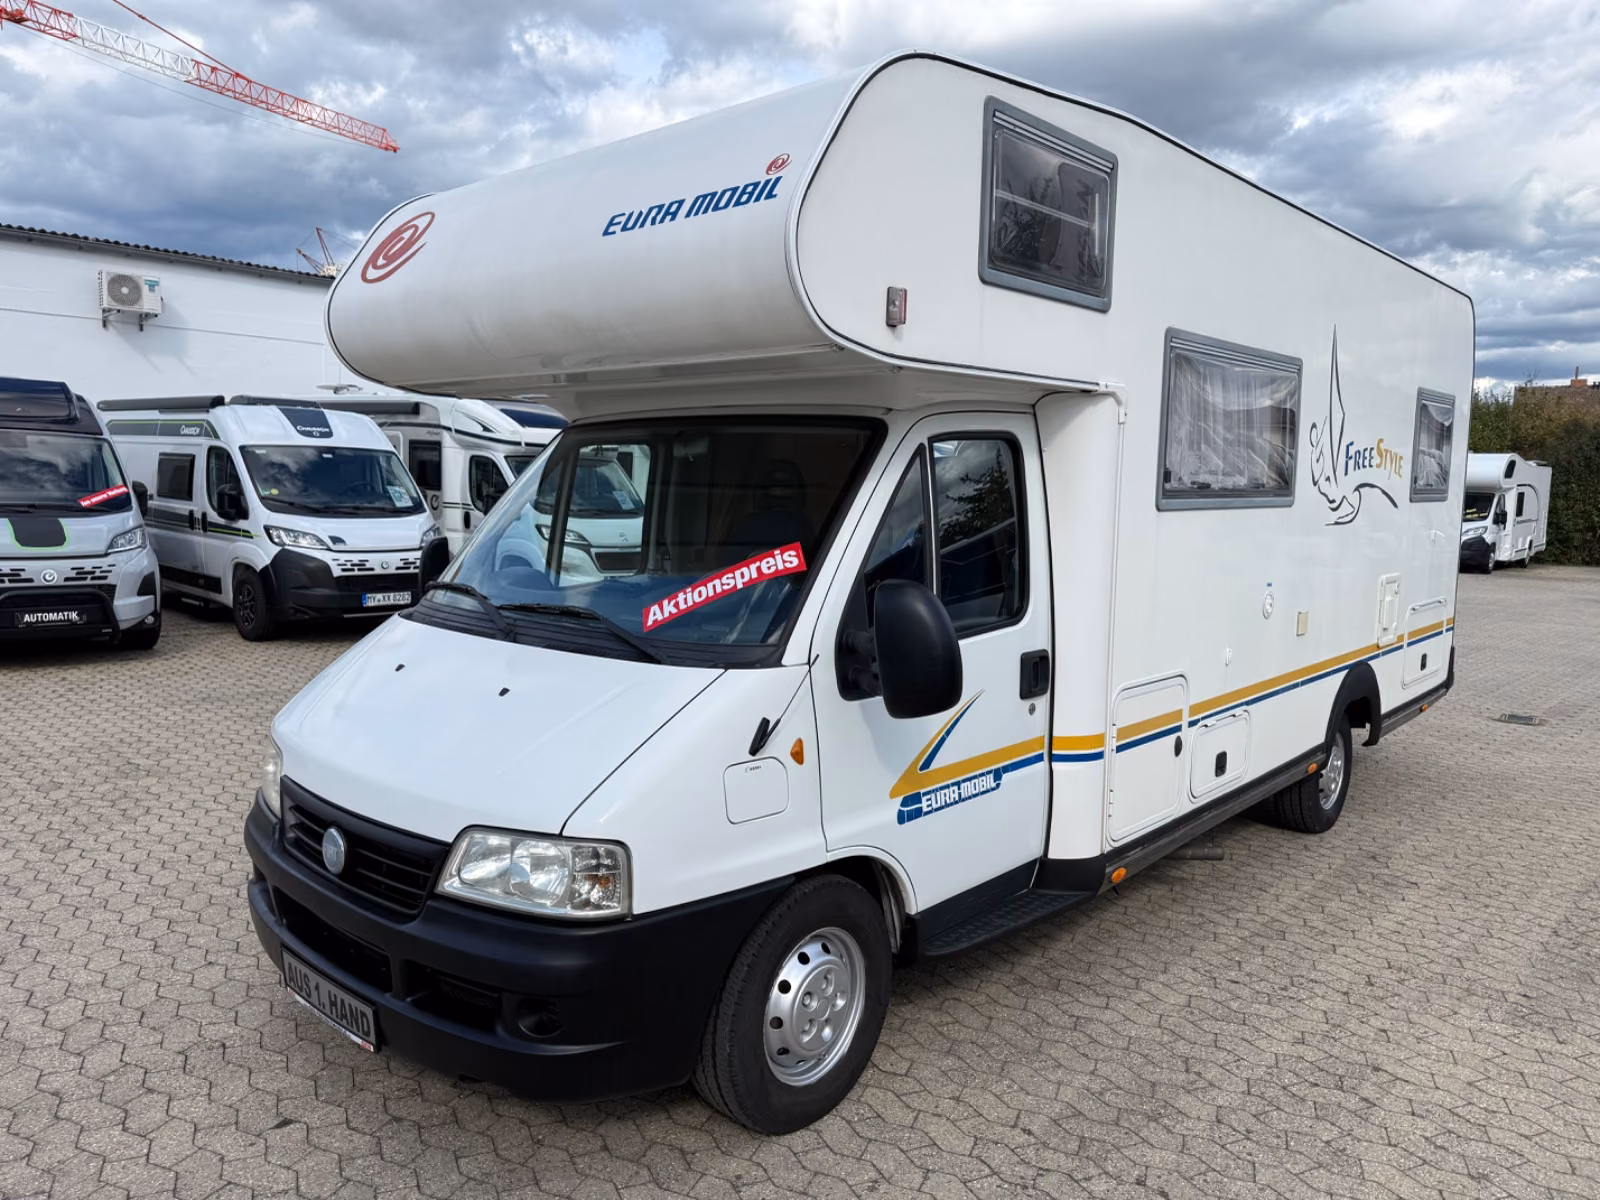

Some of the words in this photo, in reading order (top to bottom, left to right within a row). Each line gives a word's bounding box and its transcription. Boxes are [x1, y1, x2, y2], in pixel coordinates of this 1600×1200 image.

[602, 198, 686, 236] EURA
[684, 176, 783, 219] MOBIL
[23, 610, 80, 623] AUTOMATIK
[646, 548, 799, 627] Aktionspreis
[960, 773, 996, 799] MOBIL
[287, 961, 312, 1000] AUS
[314, 981, 326, 1010] 1.
[328, 989, 371, 1037] HAND
